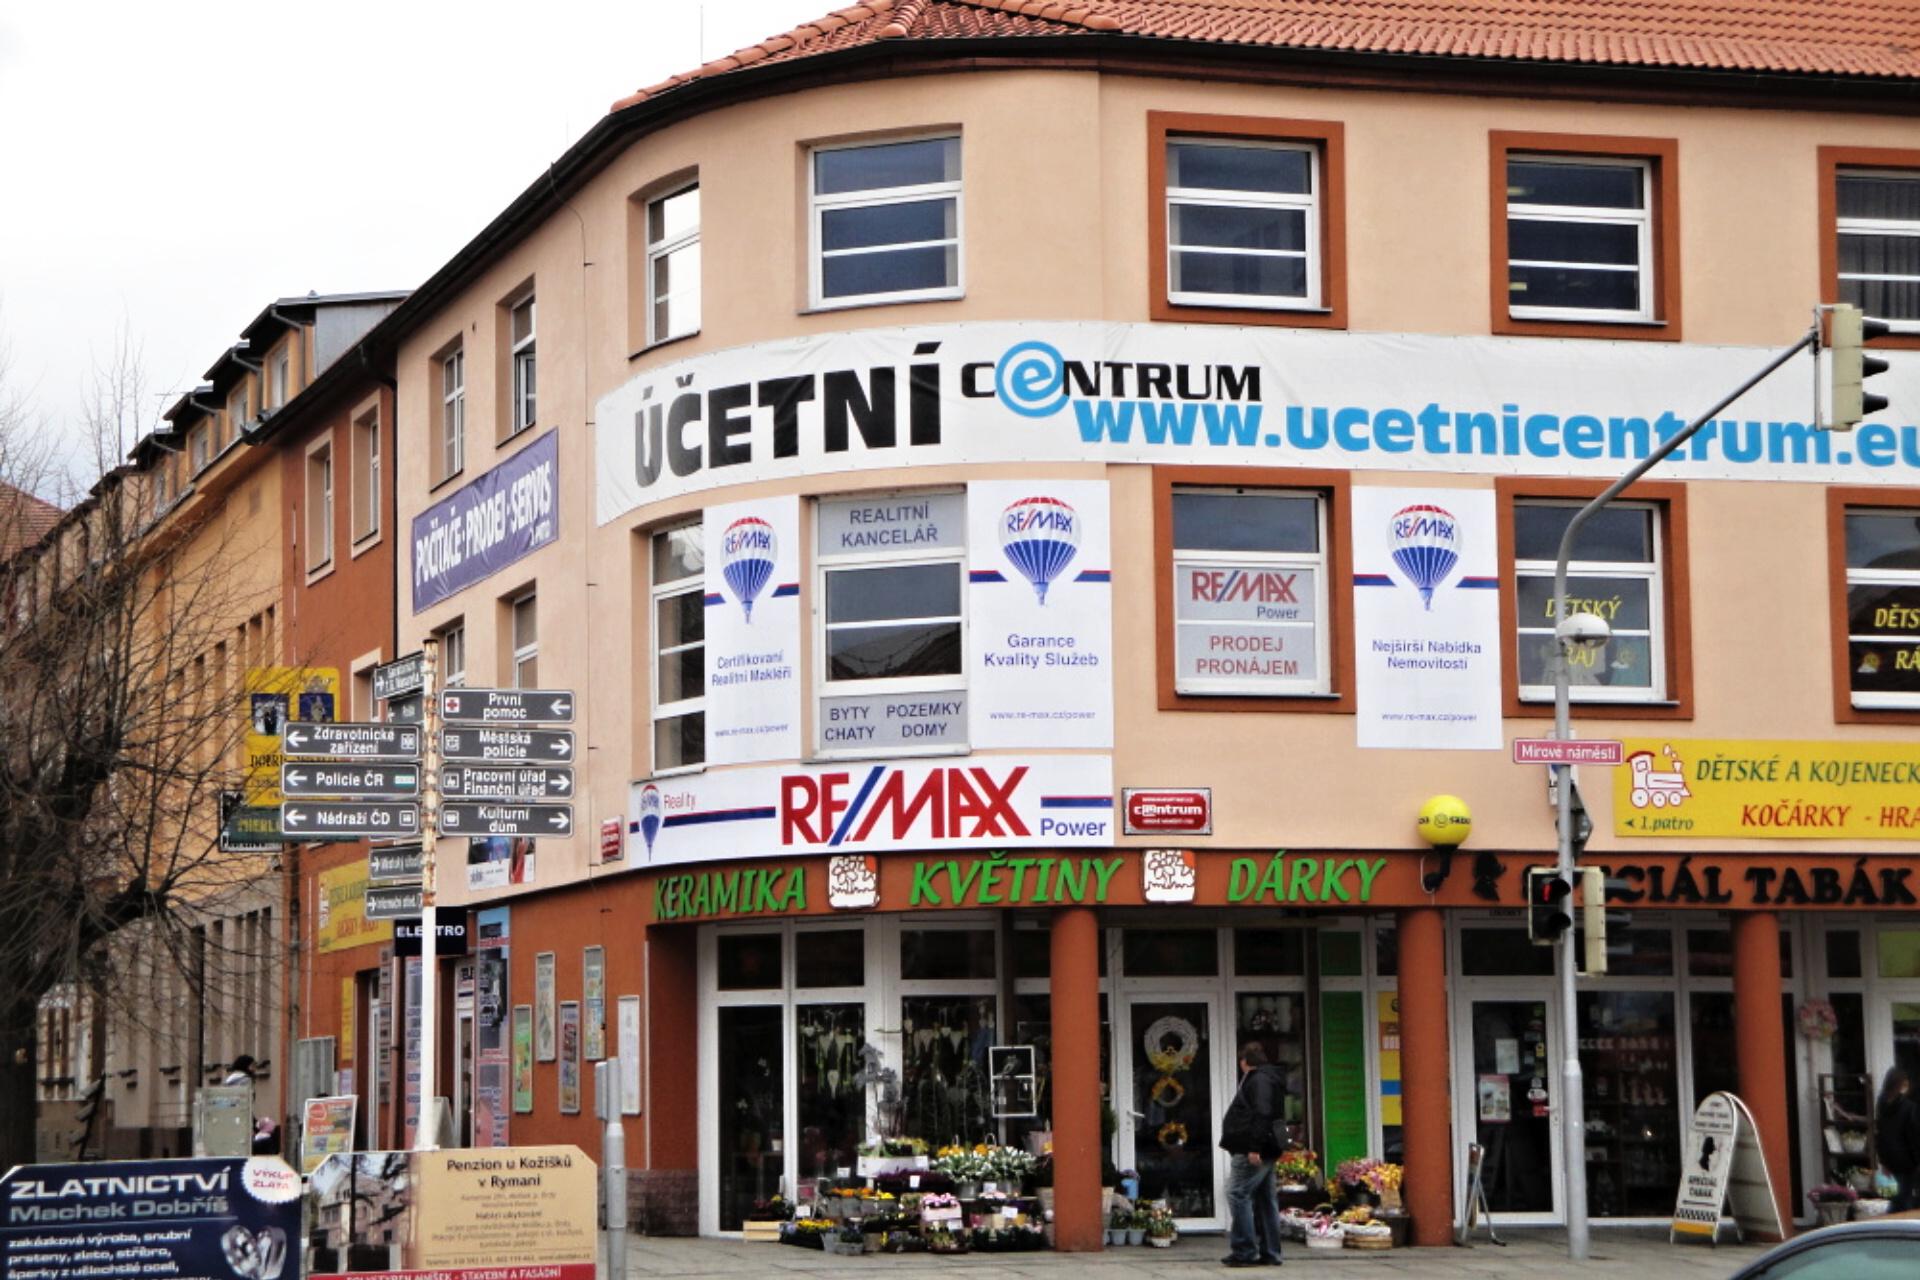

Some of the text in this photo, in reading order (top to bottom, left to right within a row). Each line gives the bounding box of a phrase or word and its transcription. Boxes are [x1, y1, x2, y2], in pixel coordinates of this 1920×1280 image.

[635, 341, 942, 488] ÚČETNÍ
[849, 503, 929, 525] REALITNÍ
[1007, 508, 1074, 535] RE/MAX
[841, 524, 938, 548] KANCELÁŘ
[1394, 516, 1455, 541] RE/MAX
[725, 529, 772, 554] RE/MAX
[1191, 569, 1298, 604] RE/MAX
[1256, 606, 1298, 619] Power
[1007, 634, 1075, 648] Garance
[1210, 635, 1284, 653] PRODEJ
[984, 652, 1099, 670] Kvality Služeb
[1196, 656, 1298, 676] PRONÁJEM
[489, 692, 523, 706] První
[483, 707, 528, 721] pomoc
[830, 702, 962, 721] BYTY POZEMKY
[314, 726, 396, 742] Zdravotnické
[479, 729, 532, 746] Městská
[825, 723, 948, 741] CHATY DOMY
[330, 740, 380, 754] zařízení
[483, 745, 528, 759] policie
[464, 767, 547, 783] Pracovní úřad
[1696, 754, 1782, 782] DĚTSKÉ
[1785, 767, 1801, 782] A
[316, 769, 385, 787] Policie ČR
[463, 780, 547, 797] Finanční úřad
[478, 806, 531, 821] Kulturní
[781, 766, 1031, 847] RE/MAX
[1740, 799, 1850, 828] KOČÁRKY
[317, 808, 391, 826] Nádraží ČD
[489, 819, 518, 834] dům
[1040, 816, 1107, 838] Power
[908, 852, 1125, 906] KVĚTINY
[1226, 850, 1387, 904] DÁRKY
[1744, 855, 1917, 905] TABÁK
[654, 866, 808, 922] KERAMIKA
[396, 925, 465, 938] ELETRO
[446, 1157, 502, 1171] Penzion
[506, 1159, 516, 1169] u
[10, 1165, 231, 1200] ZLATNICTVÍ
[478, 1173, 542, 1189] v Rymani
[10, 1196, 229, 1222] Machek Dobříš
[143, 1228, 192, 1241] snubní
